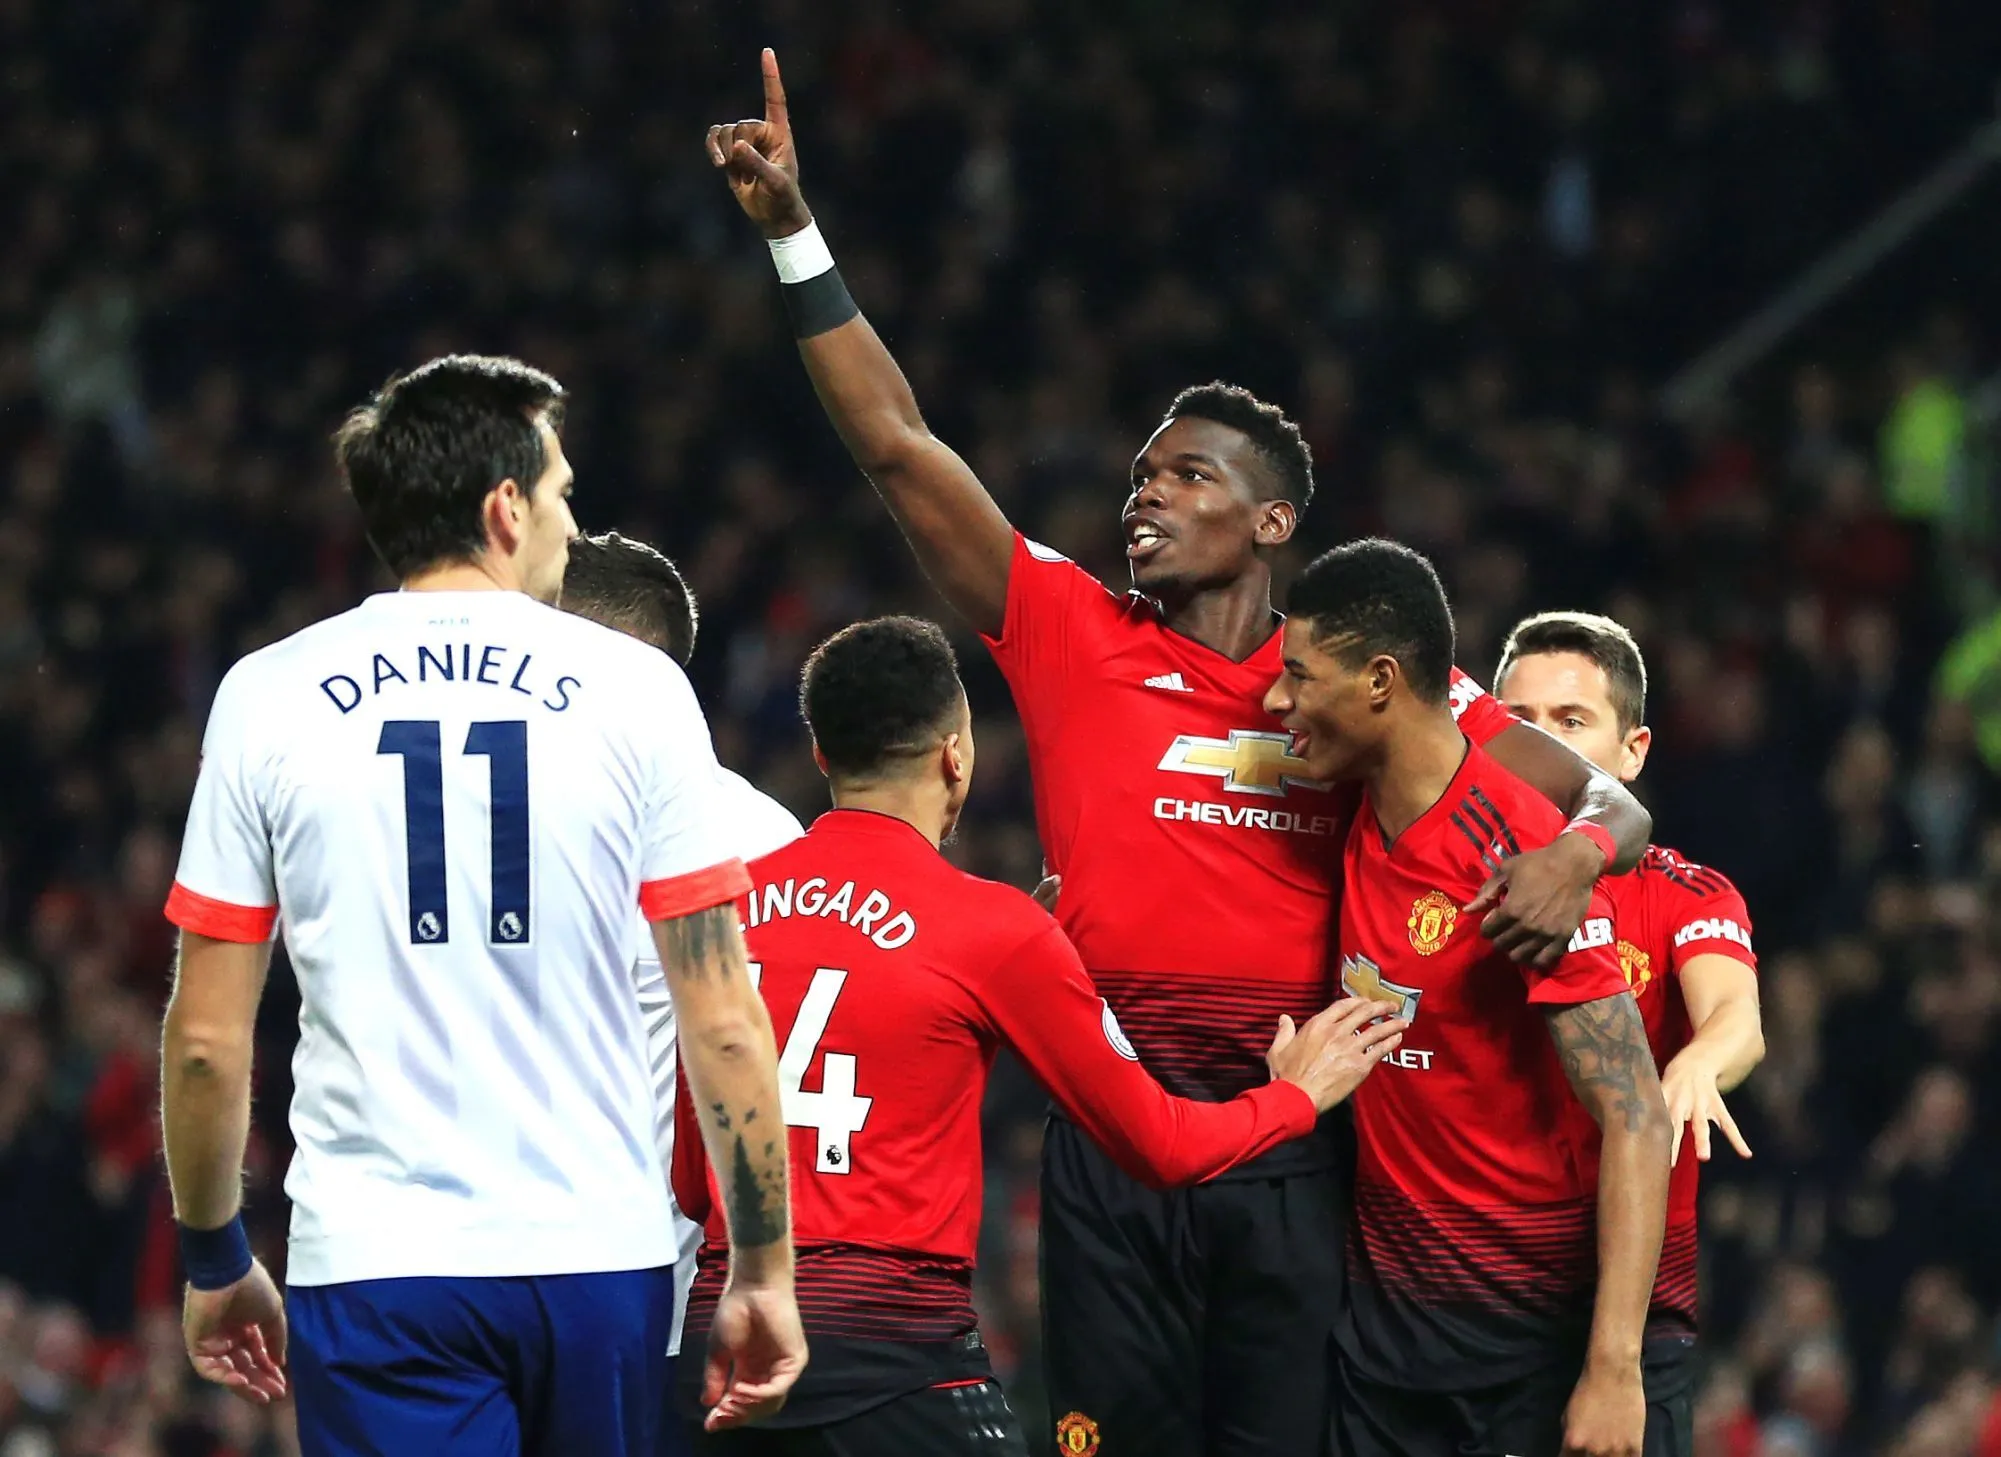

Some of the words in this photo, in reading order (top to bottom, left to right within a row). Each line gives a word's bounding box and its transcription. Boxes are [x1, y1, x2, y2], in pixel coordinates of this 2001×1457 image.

[320, 644, 582, 715] DANIELS
[376, 720, 531, 944] 11
[1154, 798, 1338, 837] CHEVROLET
[738, 877, 917, 950] INGARD
[748, 961, 873, 1175] 4
